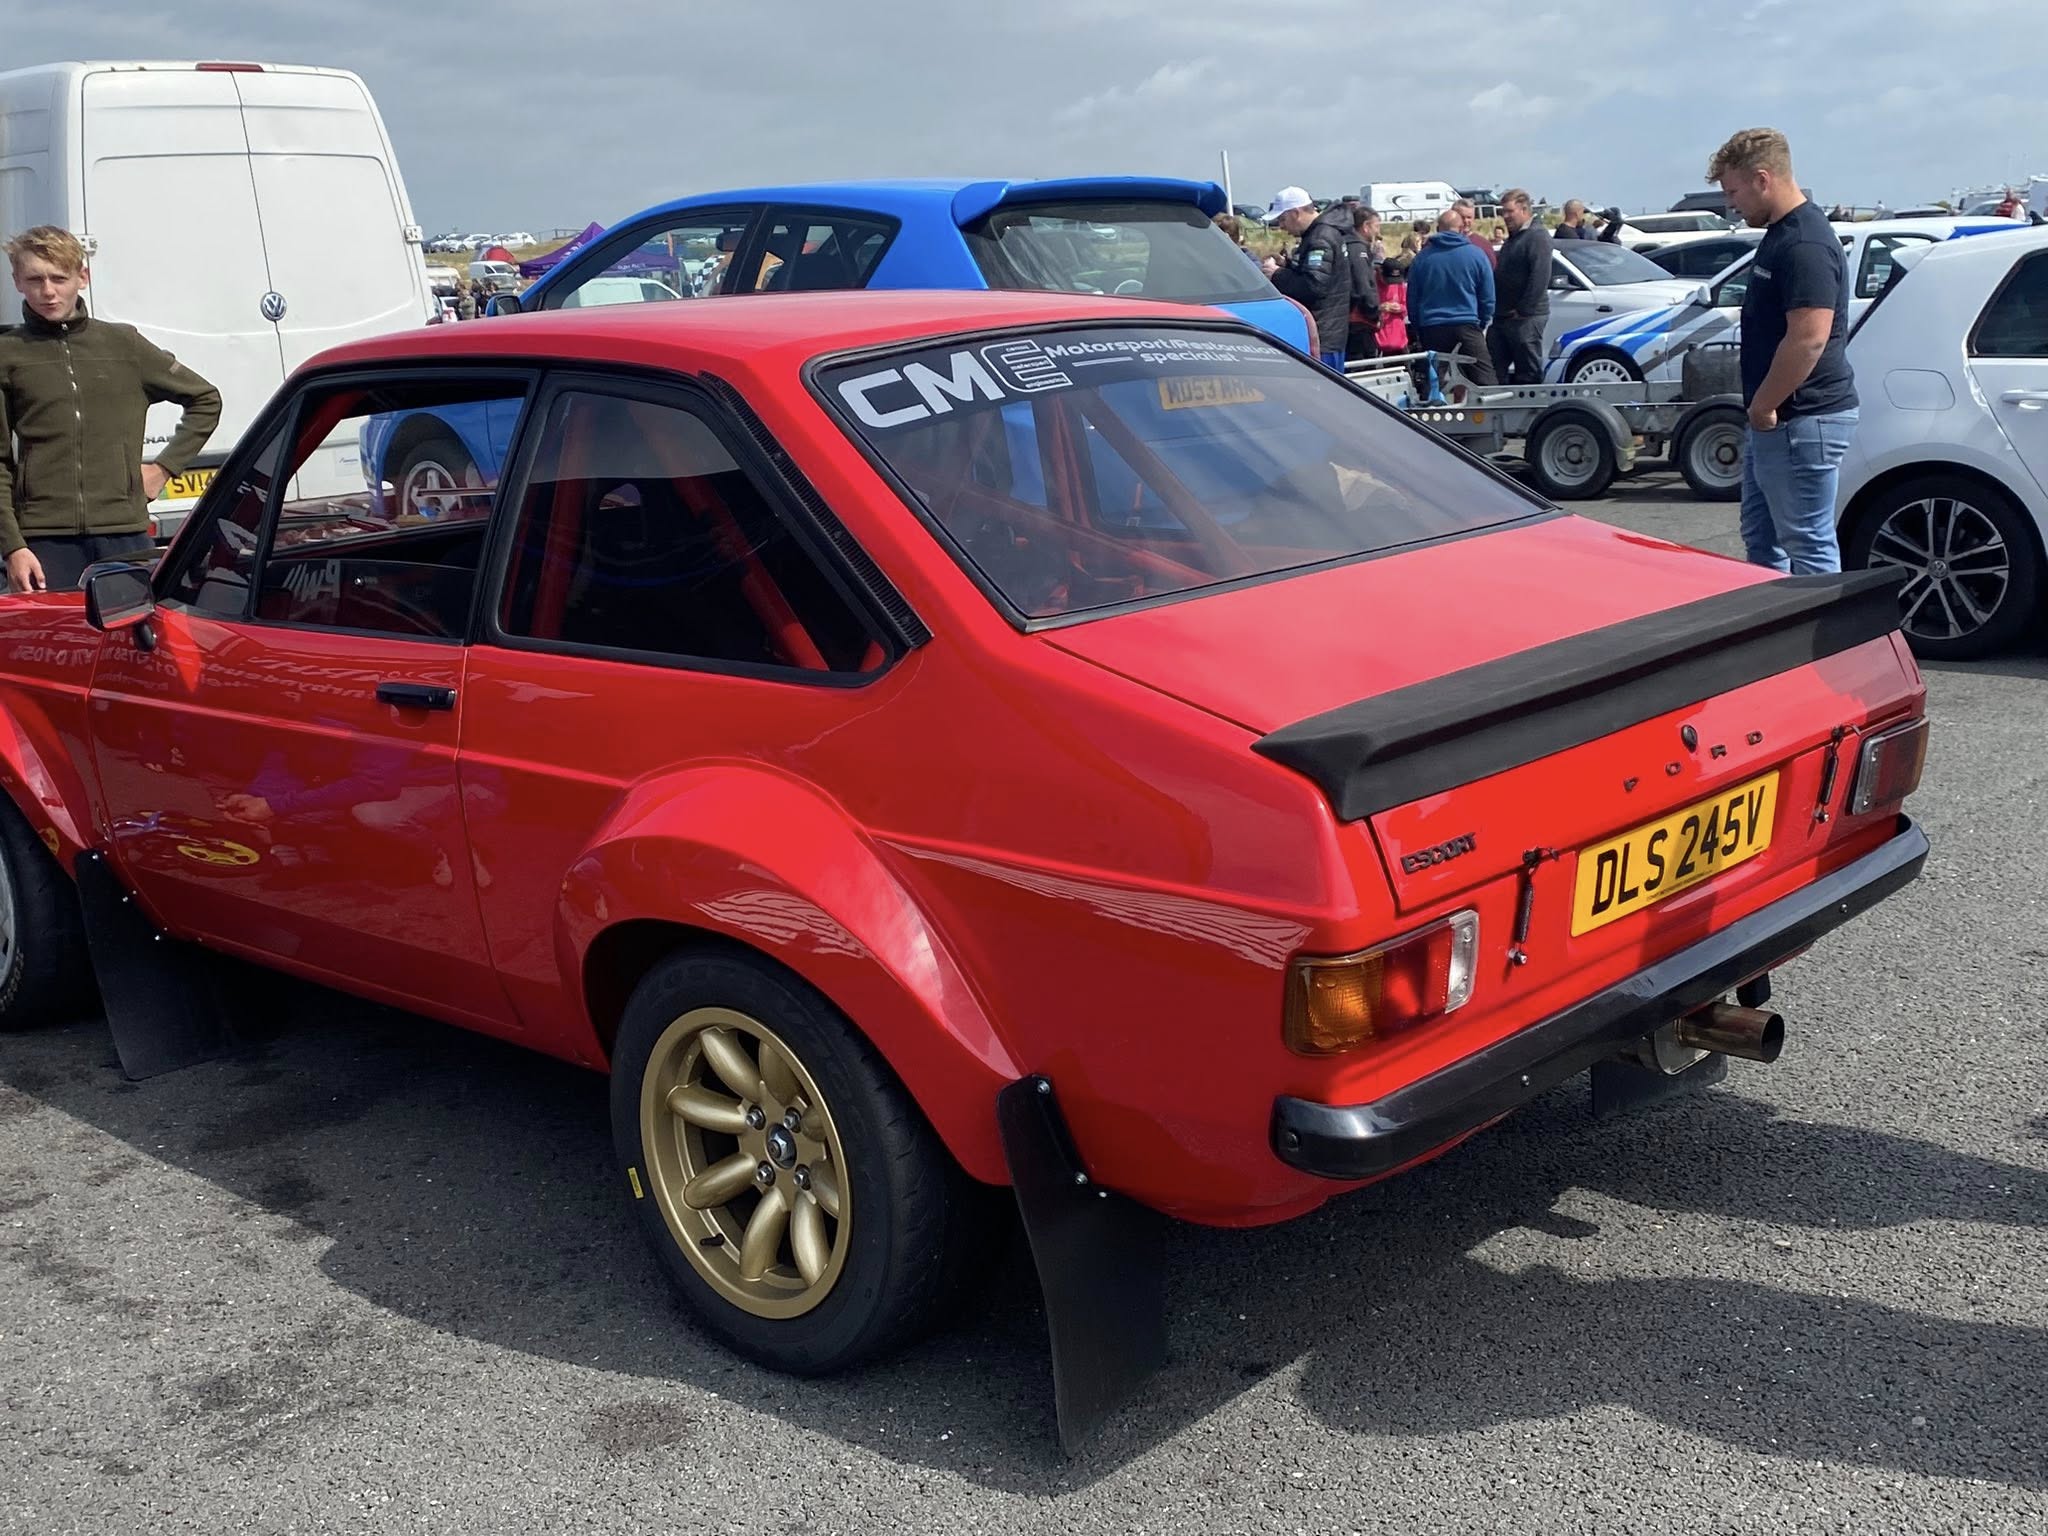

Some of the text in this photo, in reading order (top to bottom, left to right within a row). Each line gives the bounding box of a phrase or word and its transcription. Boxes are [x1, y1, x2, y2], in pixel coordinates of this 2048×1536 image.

[1140, 350, 1240, 364] specialist
[1623, 730, 1763, 793] FORD
[1400, 831, 1476, 875] ESCORT
[1591, 785, 1766, 917] DLS 245V
